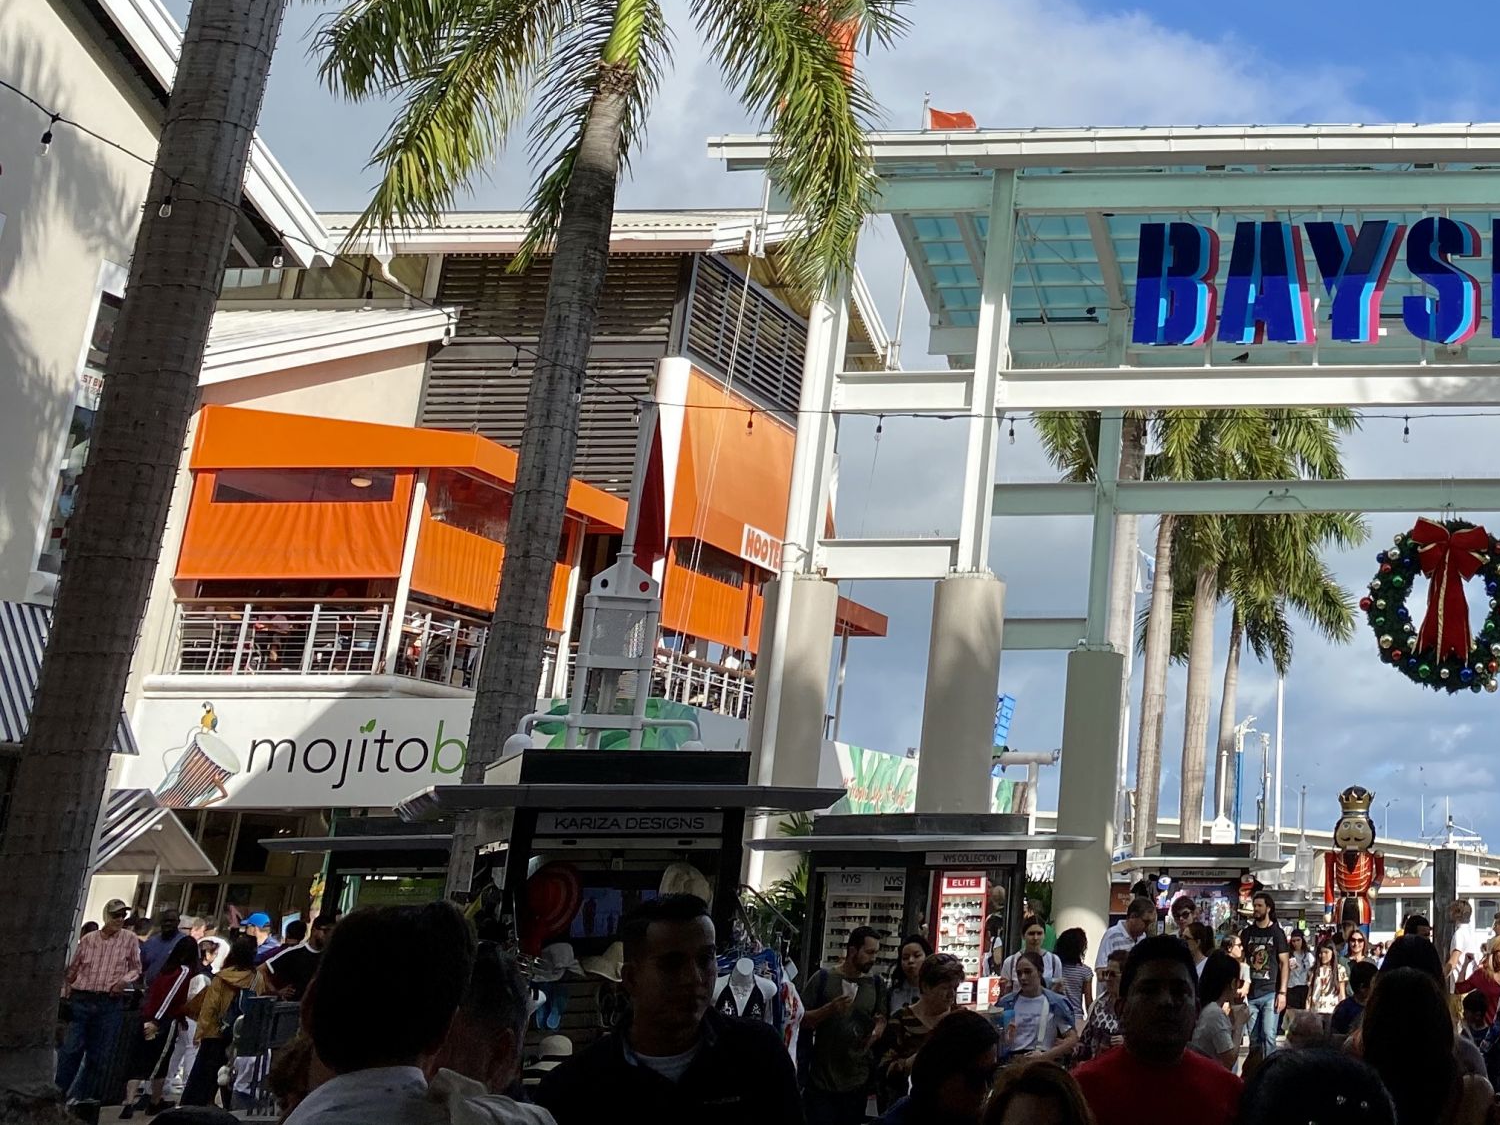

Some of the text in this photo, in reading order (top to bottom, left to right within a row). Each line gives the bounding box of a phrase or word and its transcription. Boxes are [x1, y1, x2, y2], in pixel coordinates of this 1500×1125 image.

[554, 817, 705, 830] KARIZA DESIGNS
[943, 854, 956, 863] NYS
[957, 854, 997, 863] COLLECTION
[841, 874, 861, 884] NYS
[883, 876, 904, 886] NYS
[951, 879, 976, 887] ELITE
